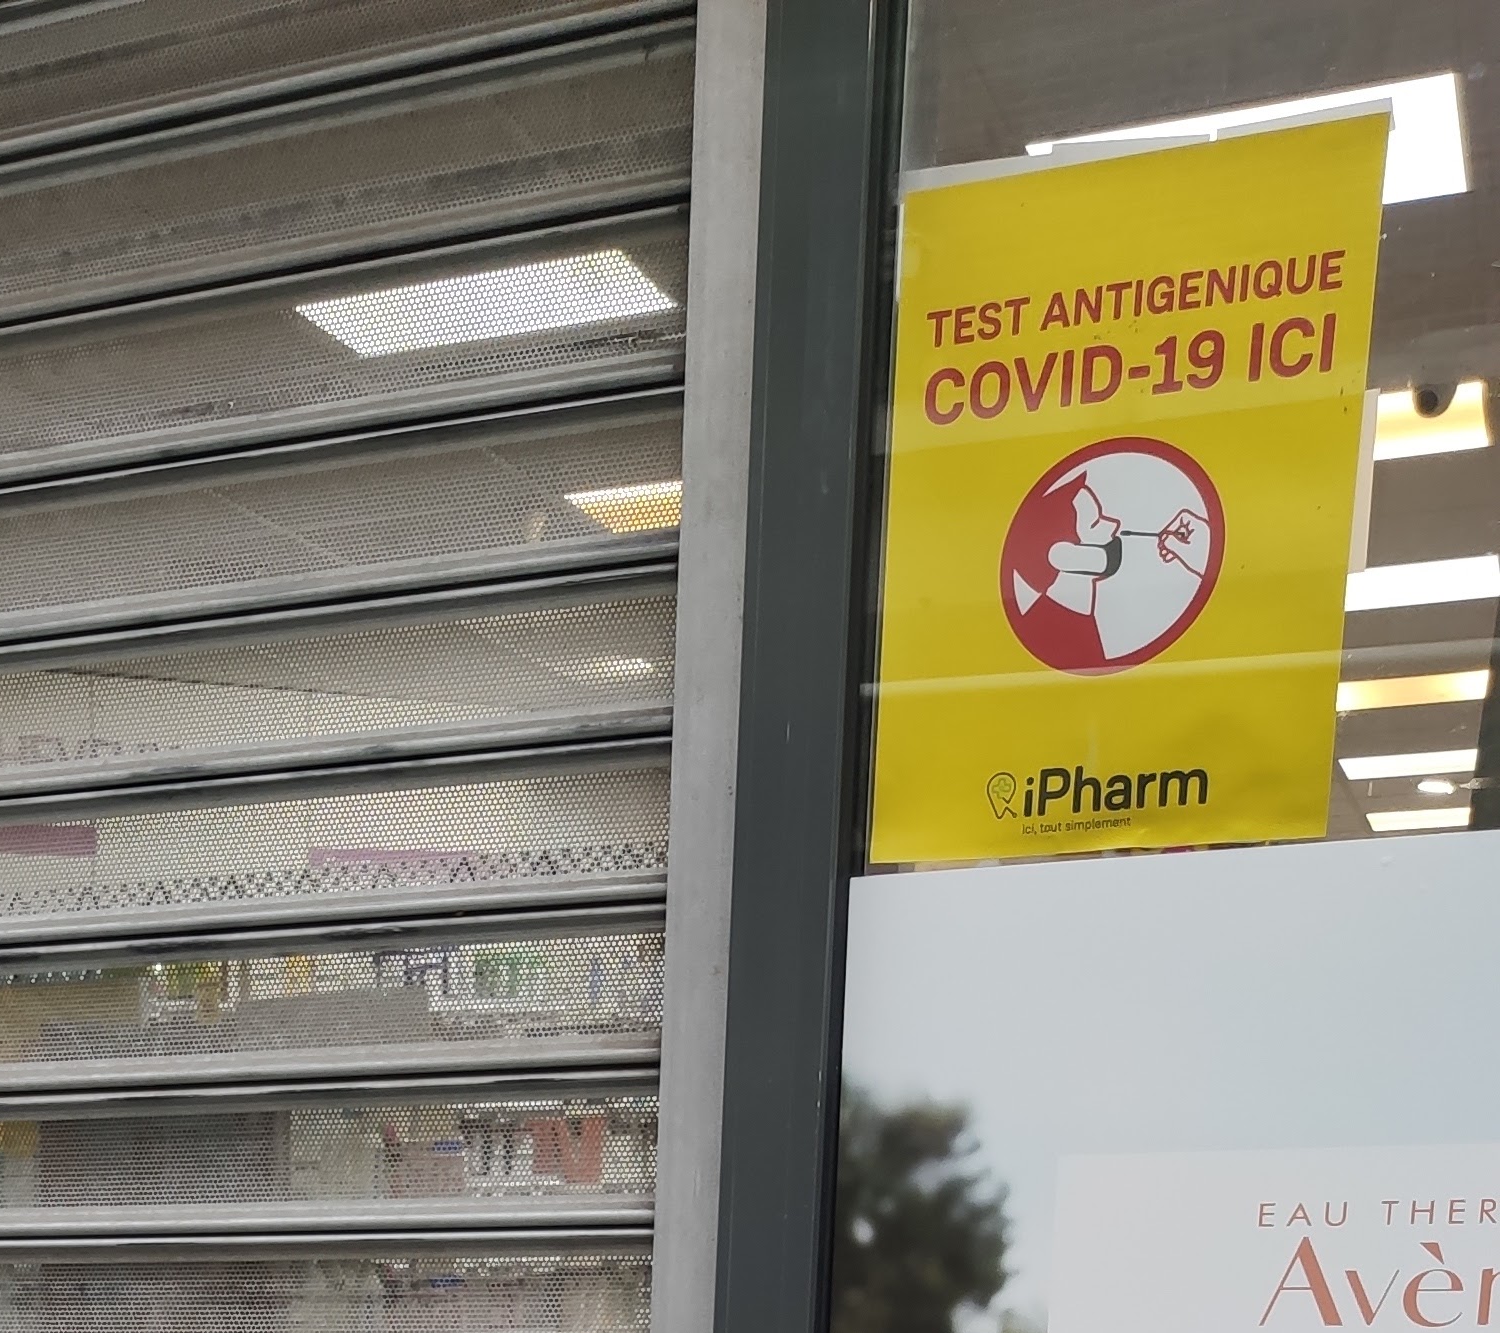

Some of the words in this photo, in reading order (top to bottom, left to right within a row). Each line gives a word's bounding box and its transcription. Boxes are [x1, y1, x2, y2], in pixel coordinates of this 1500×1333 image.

[926, 297, 1031, 347] TEST
[1040, 250, 1346, 331] ANTIGENIQUE
[924, 330, 1225, 425] COVID-19
[1248, 312, 1337, 382] ICI
[1023, 765, 1208, 817] iPharm
[1040, 820, 1063, 834] tout
[1065, 816, 1132, 833] simplement
[1258, 1201, 1348, 1227] EAU
[1381, 1198, 1498, 1225] THER
